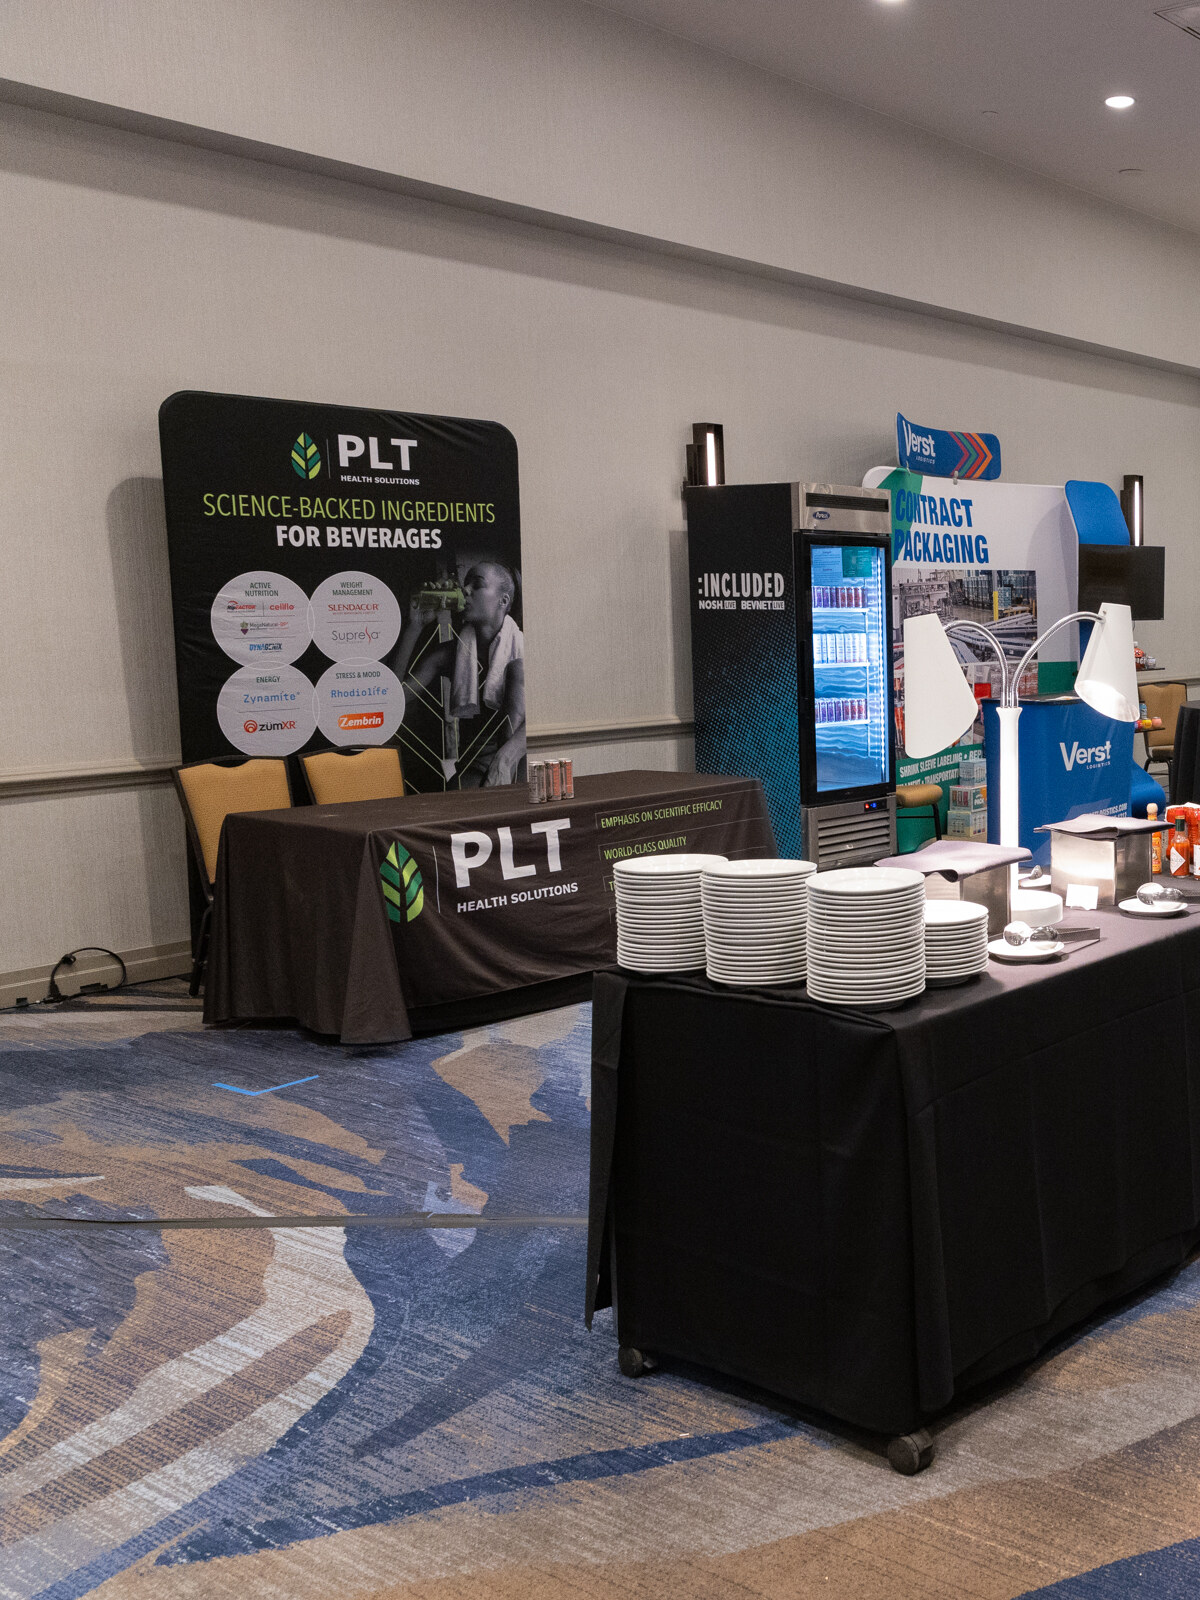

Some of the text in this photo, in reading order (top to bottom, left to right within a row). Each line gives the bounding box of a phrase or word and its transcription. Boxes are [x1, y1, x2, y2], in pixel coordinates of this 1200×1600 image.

[902, 420, 936, 457] Verst
[337, 434, 418, 471] PLT
[340, 474, 420, 486] HEALTH SOLUTIONS
[203, 493, 496, 523] SCIENCE-BACKED INGREDIENTS
[895, 488, 973, 528] CONTRACT
[276, 525, 442, 549] FOR BEVERAGES
[893, 528, 990, 564] PACKAGING
[698, 600, 723, 610] NOSH
[741, 600, 772, 610] BEVNET
[256, 675, 280, 683] ENERGY
[243, 691, 296, 704] Zynamite
[331, 686, 387, 698] Rhodiolife
[259, 720, 296, 732] zümXR
[339, 715, 381, 728] Zembrin
[919, 757, 936, 772] SLEEVE
[936, 752, 962, 768] LABELING
[1059, 741, 1111, 771] Verst
[1086, 761, 1111, 770] LOGISTICS
[601, 799, 723, 829] EMPHASIS ON SCIENTIFIC EFFICACY
[450, 817, 571, 888] PLT
[604, 836, 687, 860] WORLD-CLASS QUALITY
[456, 882, 579, 913] HEALTH SOLUTIONS
